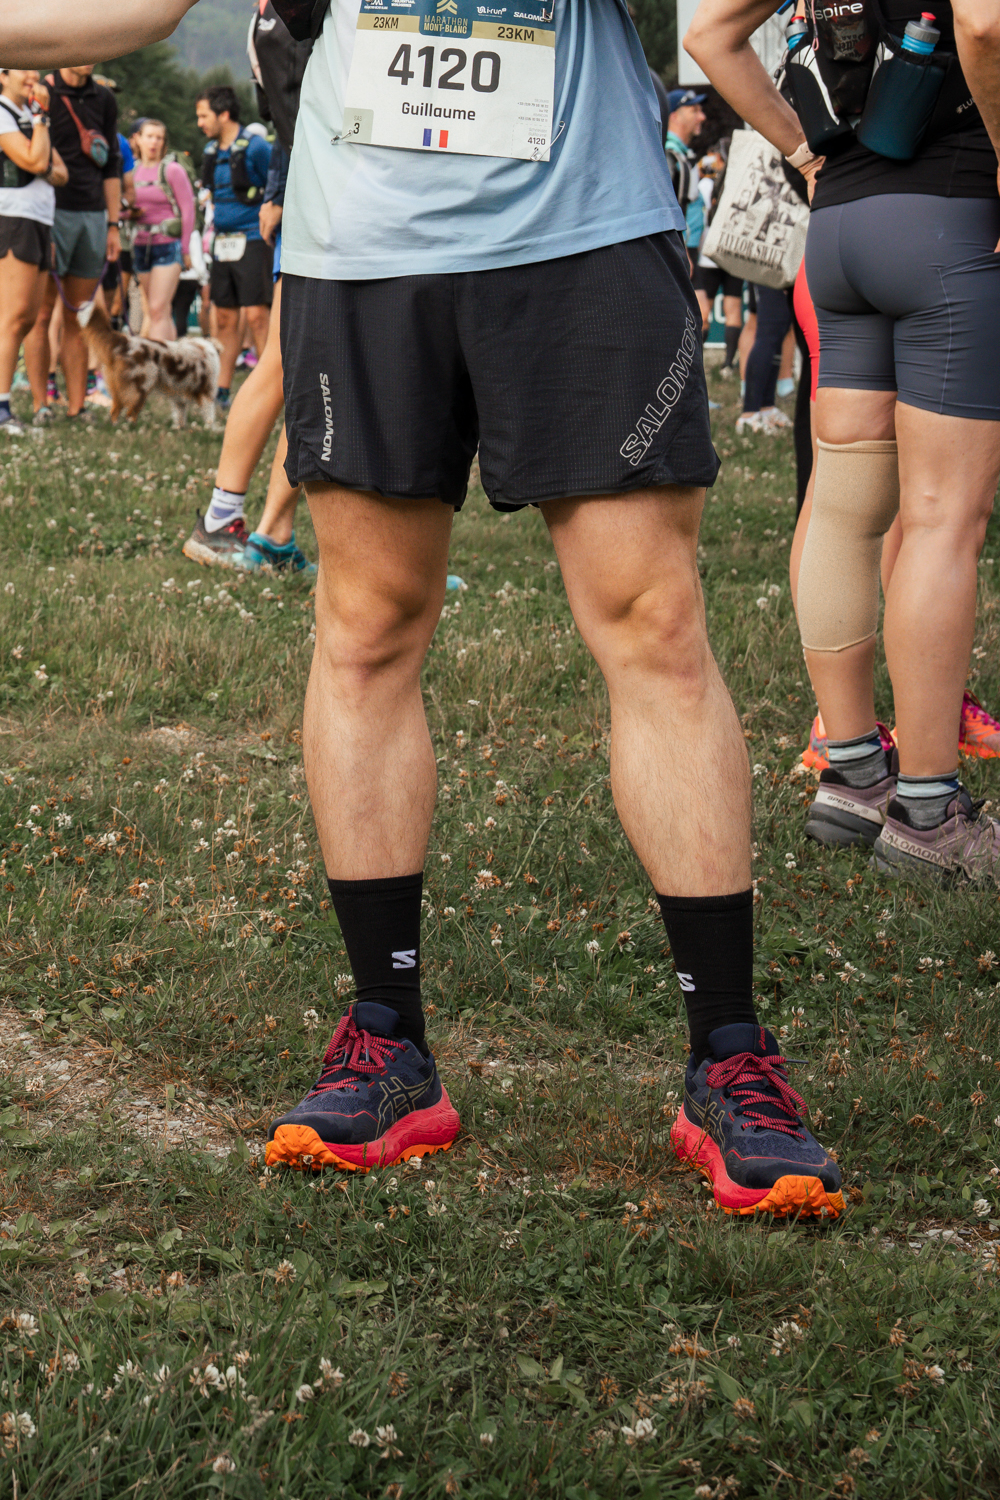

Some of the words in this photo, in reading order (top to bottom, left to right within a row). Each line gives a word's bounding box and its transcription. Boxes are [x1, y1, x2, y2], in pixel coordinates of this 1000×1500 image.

[373, 16, 399, 29] 23KM
[424, 14, 468, 27] MARATHON
[497, 26, 535, 42] 23KM
[387, 43, 501, 93] 4120
[401, 101, 476, 121] Guillaume
[353, 122, 360, 135] 3
[527, 136, 546, 146] 4120
[619, 307, 696, 467] SALOMON
[319, 373, 333, 462] SALOMON
[826, 795, 855, 808] SPEED
